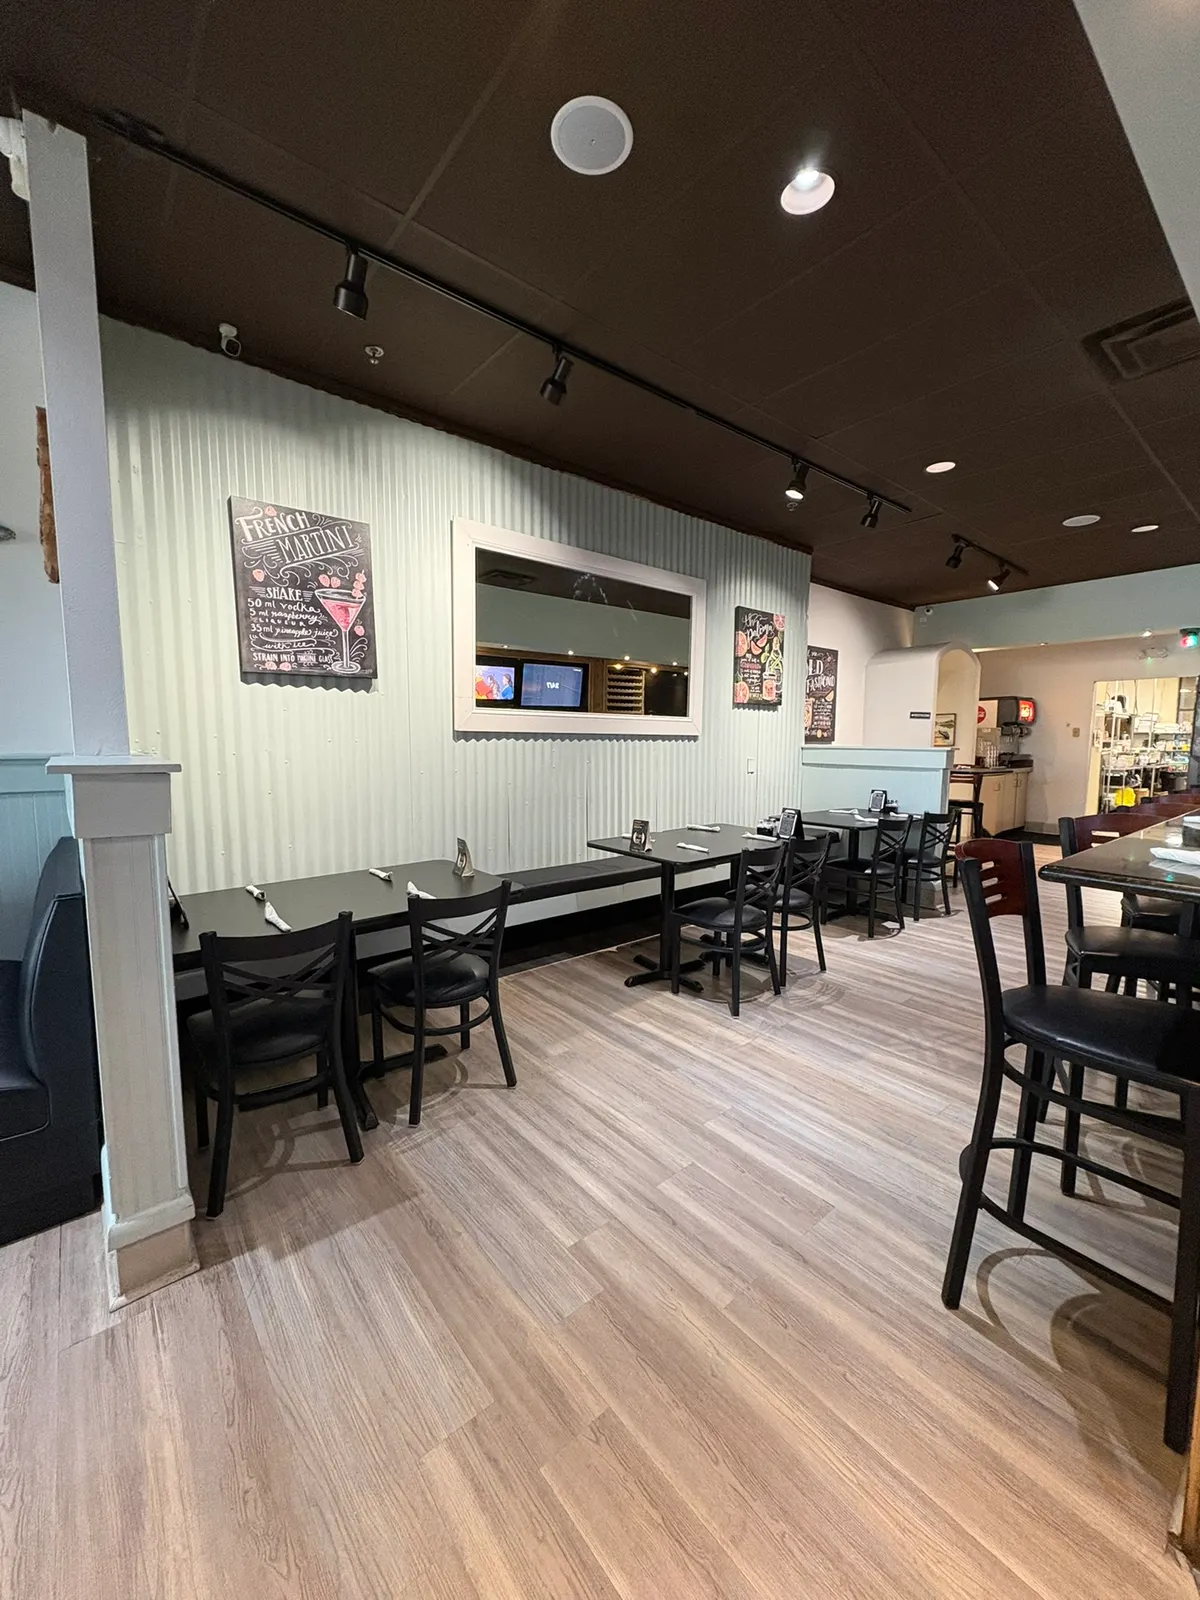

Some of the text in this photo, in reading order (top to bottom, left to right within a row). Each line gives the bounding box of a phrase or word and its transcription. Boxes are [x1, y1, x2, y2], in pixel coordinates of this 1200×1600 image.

[235, 507, 310, 541] FRENCH
[276, 525, 355, 563] MARTINI
[266, 586, 303, 601] SHAKE
[247, 598, 320, 613] 50 ml vodka
[249, 608, 256, 616] 5
[271, 611, 322, 625] raspberry
[250, 623, 338, 638] 35 ml pineapple juice
[252, 652, 278, 662] STRAIN
[280, 653, 295, 662] INTO
[808, 658, 824, 676] LD
